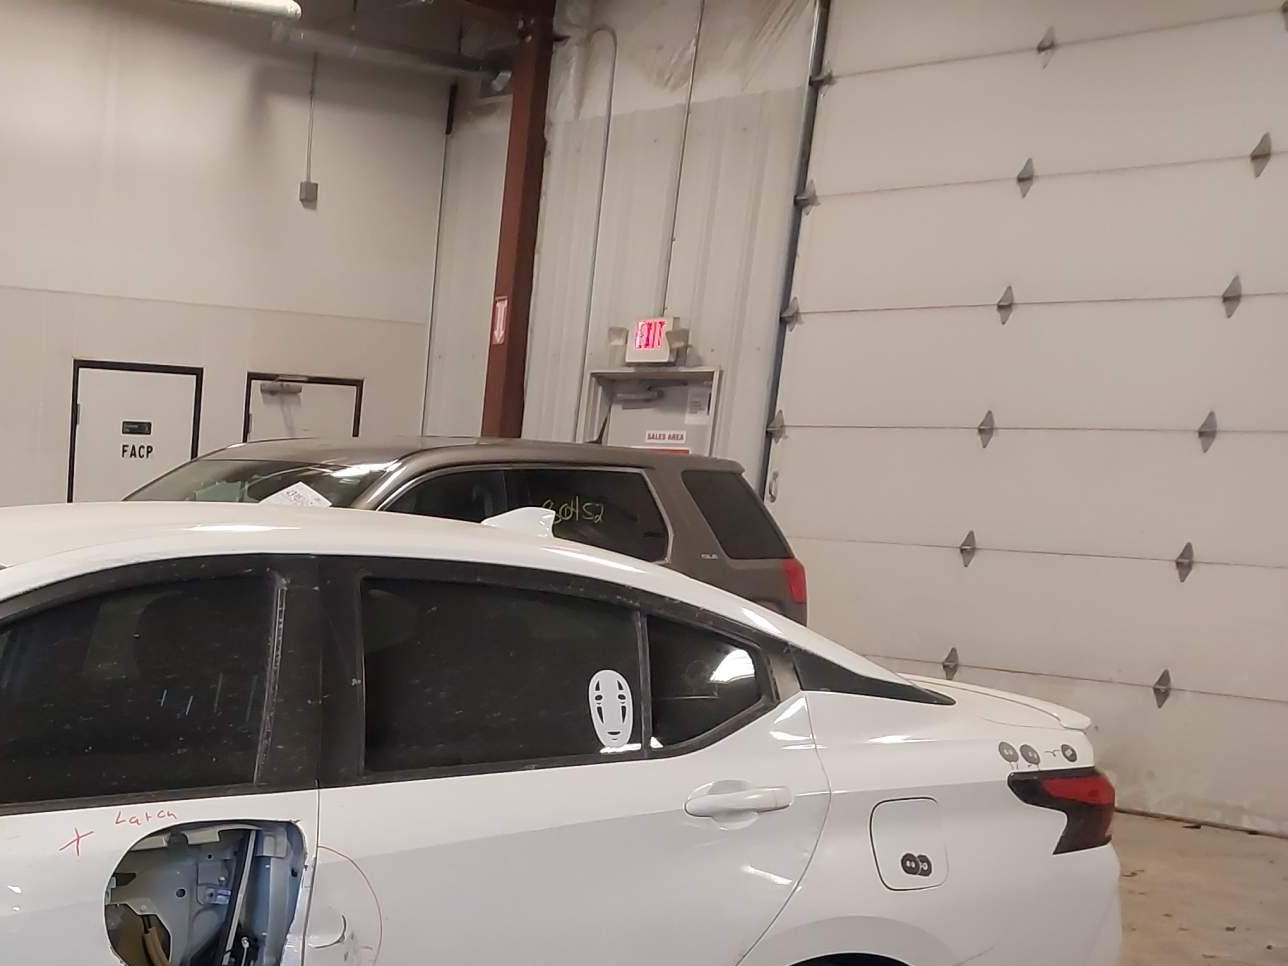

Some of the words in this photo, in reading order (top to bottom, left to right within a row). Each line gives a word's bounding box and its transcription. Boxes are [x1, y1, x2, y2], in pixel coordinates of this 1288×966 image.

[635, 320, 666, 348] EXIT
[647, 433, 666, 441] SALES
[667, 433, 685, 441] AREA
[122, 444, 153, 459] FACP
